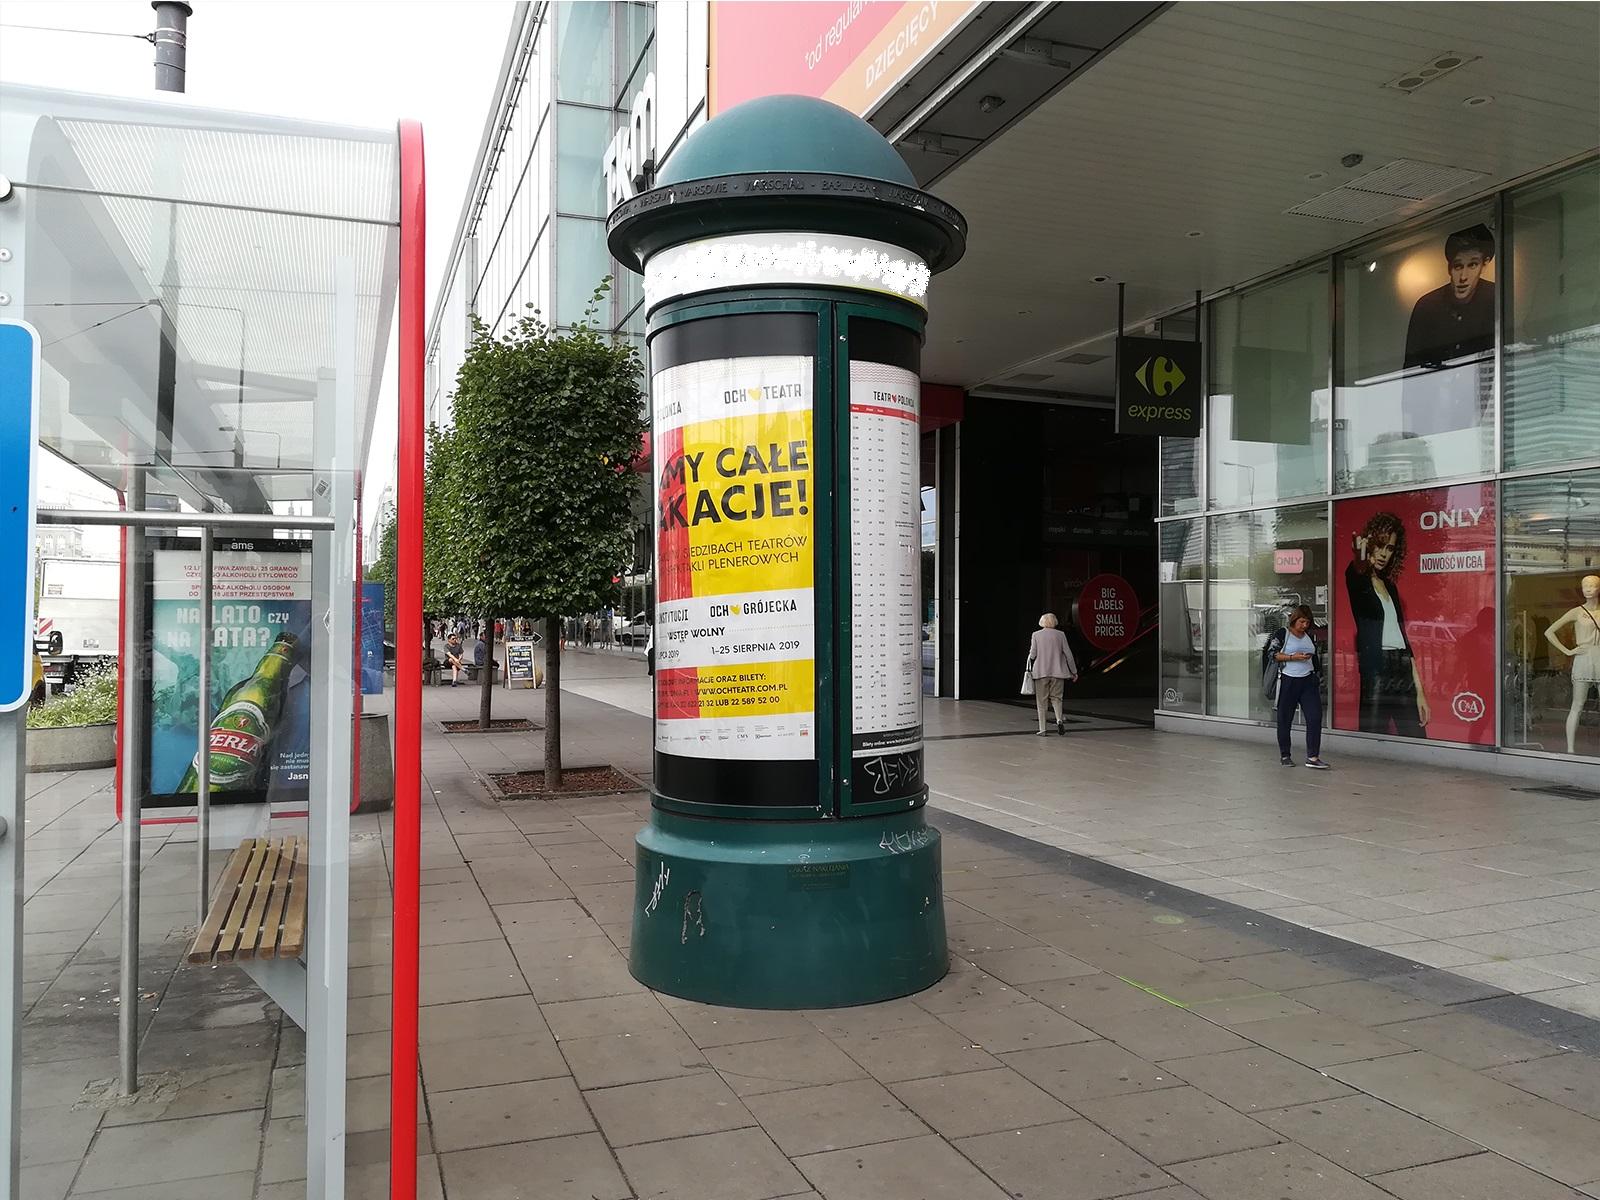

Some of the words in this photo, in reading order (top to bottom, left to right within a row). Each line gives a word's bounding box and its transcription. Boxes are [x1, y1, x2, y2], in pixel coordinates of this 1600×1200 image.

[724, 388, 747, 405] OCH
[763, 383, 802, 400] TEATR
[873, 390, 892, 403] TEATR
[1127, 404, 1192, 422] express
[715, 440, 809, 478] CAŁE
[1419, 506, 1485, 531] ONLY
[231, 541, 254, 550] ams
[747, 534, 808, 551] TEATRÓW
[708, 552, 799, 570] PLENEROWYCH
[1276, 556, 1302, 566] ONLY
[1421, 555, 1456, 571] NOWOŚĆ
[1456, 557, 1465, 569] W
[1101, 587, 1116, 599] BIG
[710, 604, 729, 618] OCH
[743, 599, 798, 615] GRÓJECKA
[1093, 599, 1124, 610] LABELS
[176, 607, 200, 624] NA
[267, 612, 289, 624] CZY
[1095, 613, 1123, 625] SMALL
[167, 631, 192, 648] NA
[211, 626, 271, 648] ATA?
[690, 626, 726, 639] WOLNY
[1094, 625, 1125, 637] PRICES
[732, 642, 776, 654] SIERPNIA
[779, 640, 800, 651] 2019
[715, 675, 737, 684] ORAZ
[739, 673, 766, 683] BILETY:
[707, 699, 714, 707] 32
[715, 698, 729, 707] LUB
[731, 698, 739, 706] 22
[742, 697, 756, 705] 589
[758, 696, 767, 704] 52
[769, 695, 780, 704] 00
[279, 751, 293, 759] Nad
[294, 751, 309, 760] jedn
[287, 772, 309, 780] Jasn
